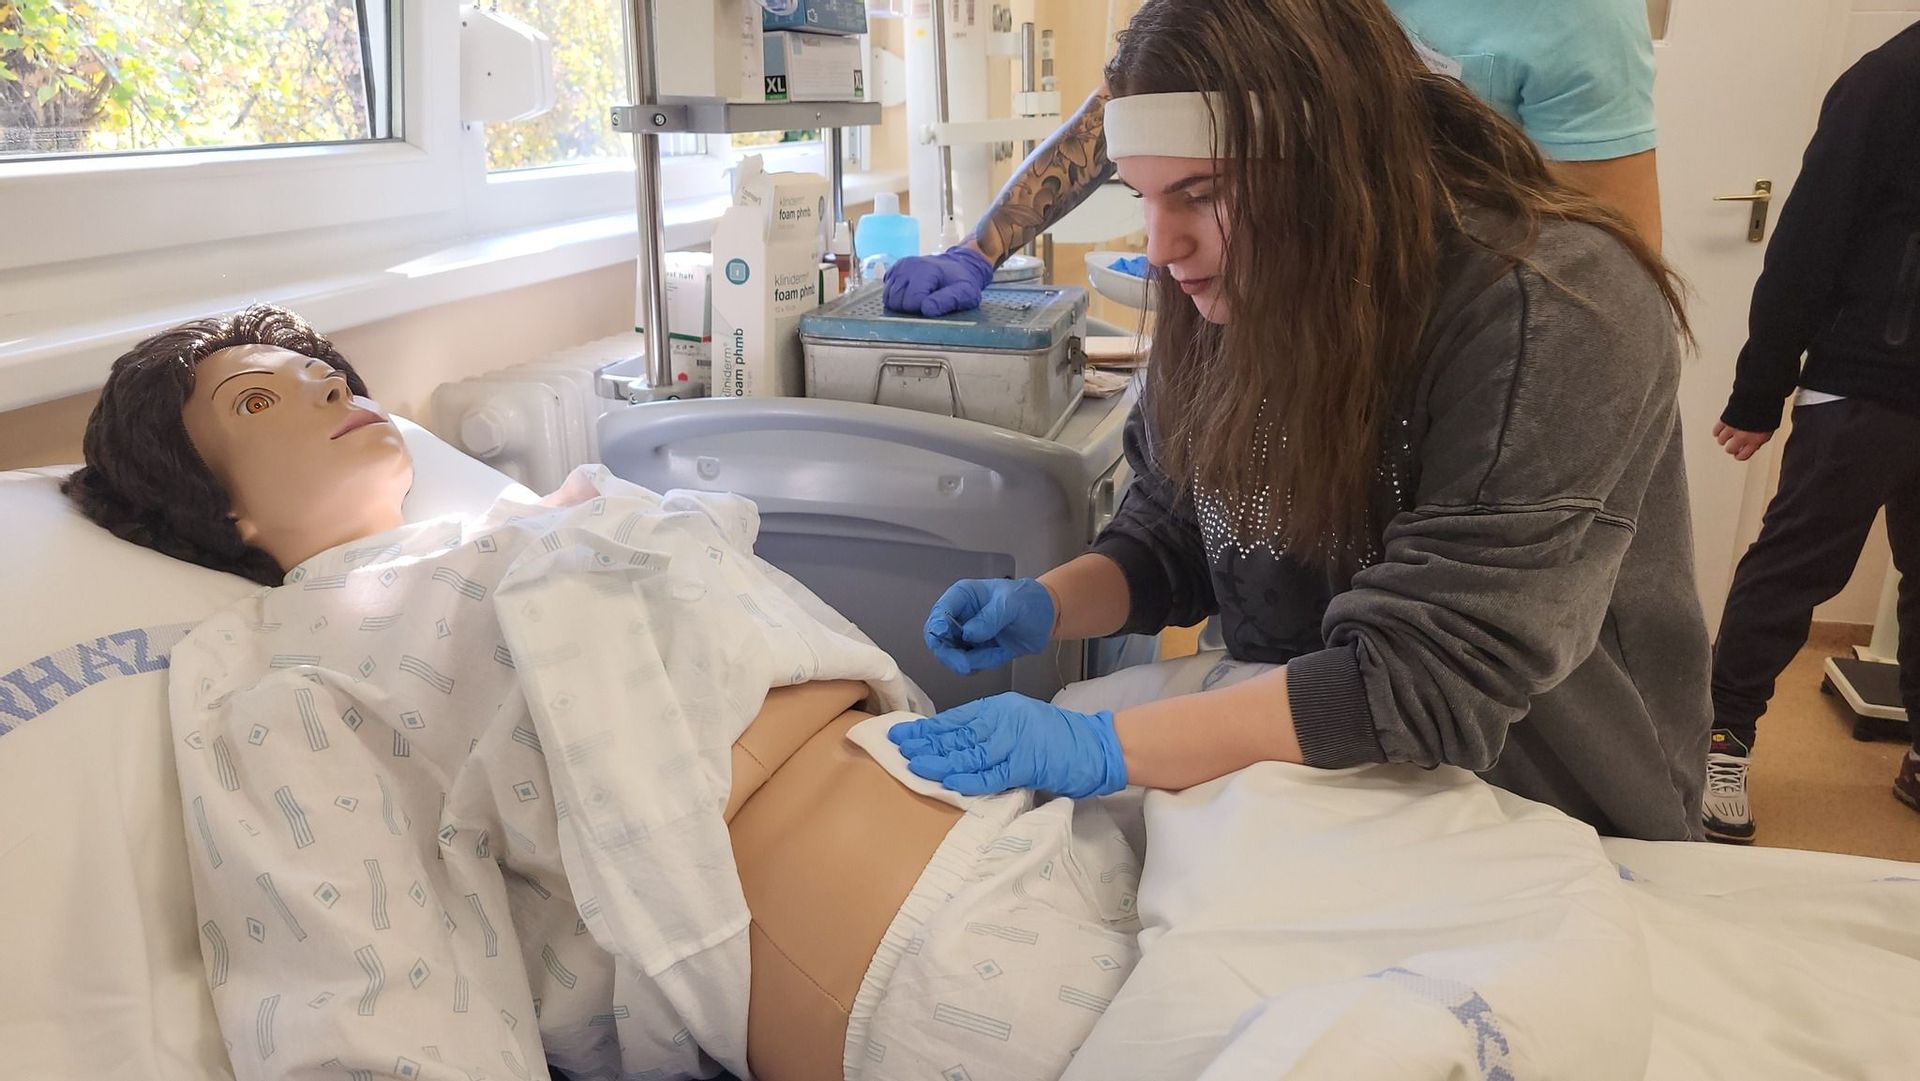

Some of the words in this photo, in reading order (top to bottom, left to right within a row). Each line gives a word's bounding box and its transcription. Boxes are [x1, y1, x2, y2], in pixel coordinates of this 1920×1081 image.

[766, 77, 786, 93] XL
[854, 72, 863, 89] XL
[779, 208, 795, 220] foam
[797, 207, 811, 220] phmb
[774, 288, 798, 302] foam
[733, 328, 745, 365] phmb
[735, 369, 744, 398] oam
